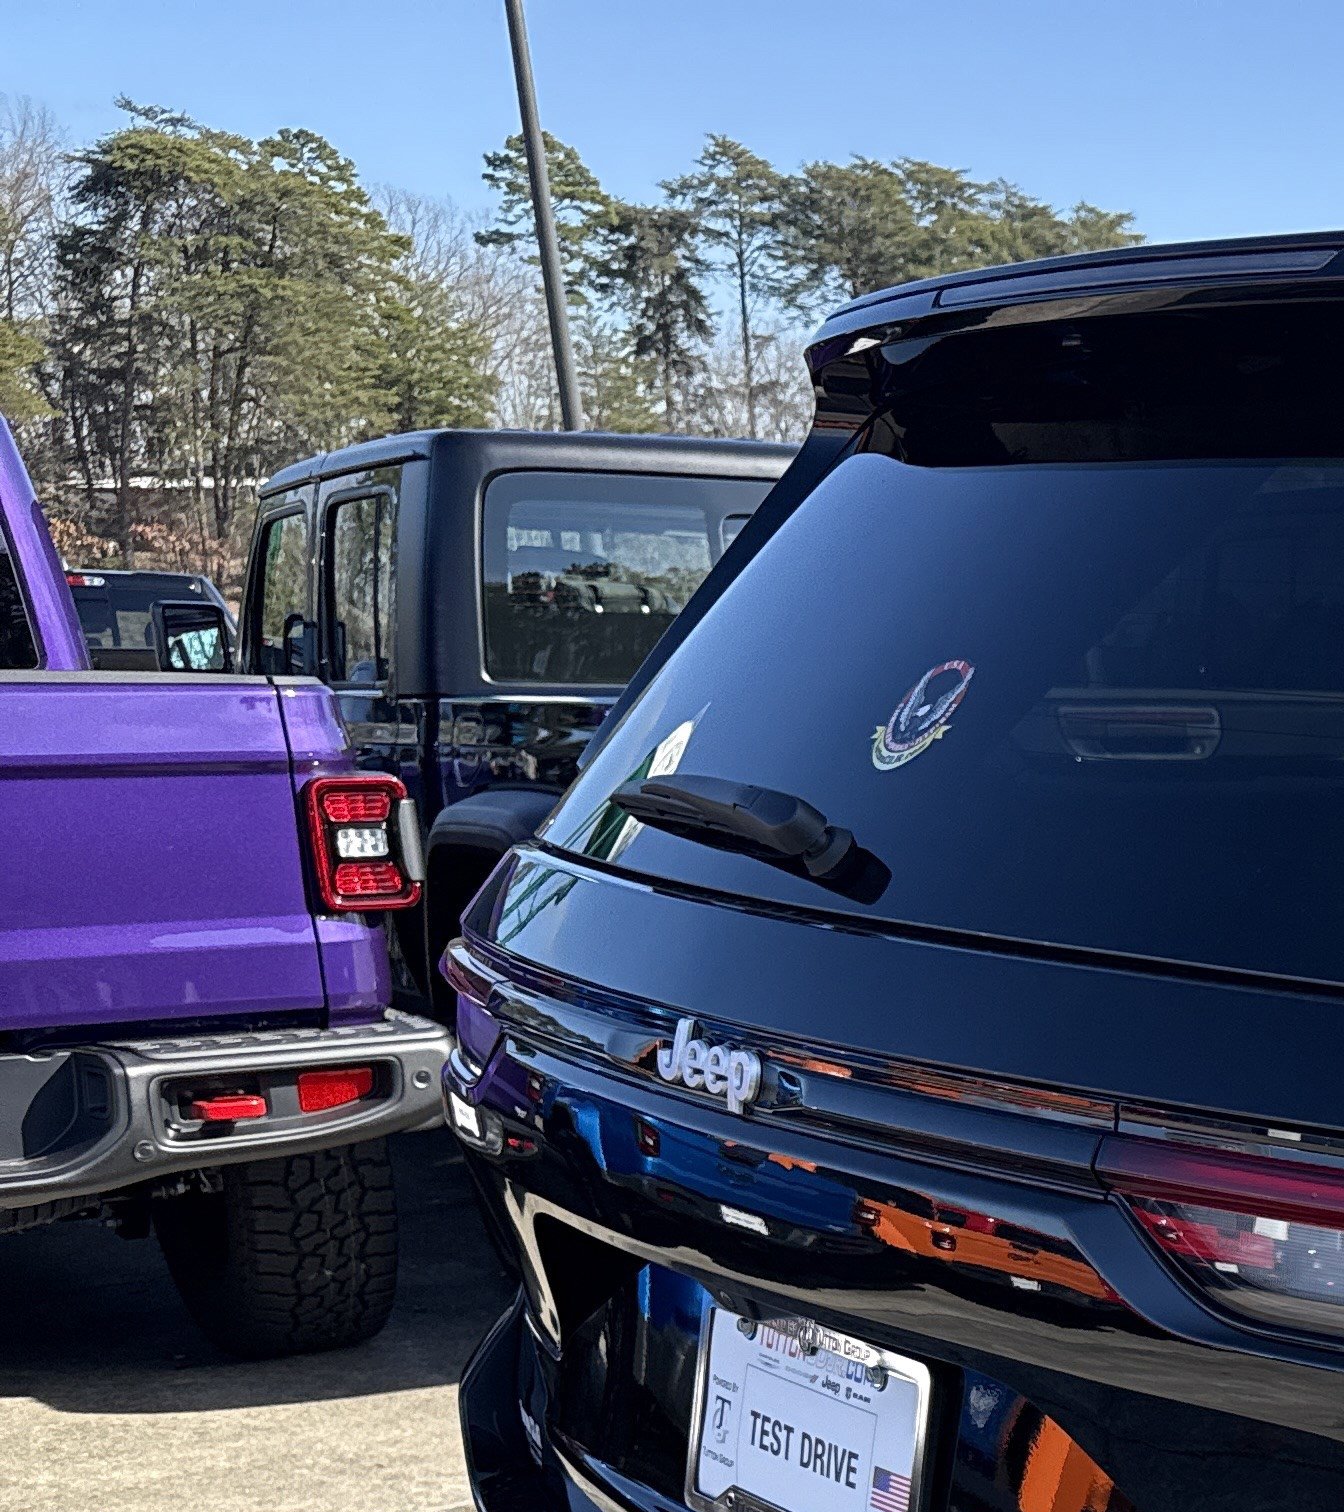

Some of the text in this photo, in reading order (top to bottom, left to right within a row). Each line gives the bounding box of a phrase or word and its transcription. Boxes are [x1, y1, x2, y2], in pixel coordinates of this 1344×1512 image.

[657, 1017, 761, 1115] Jeep
[822, 1375, 841, 1396] Jeep
[750, 1409, 859, 1489] TEST DRIVE
